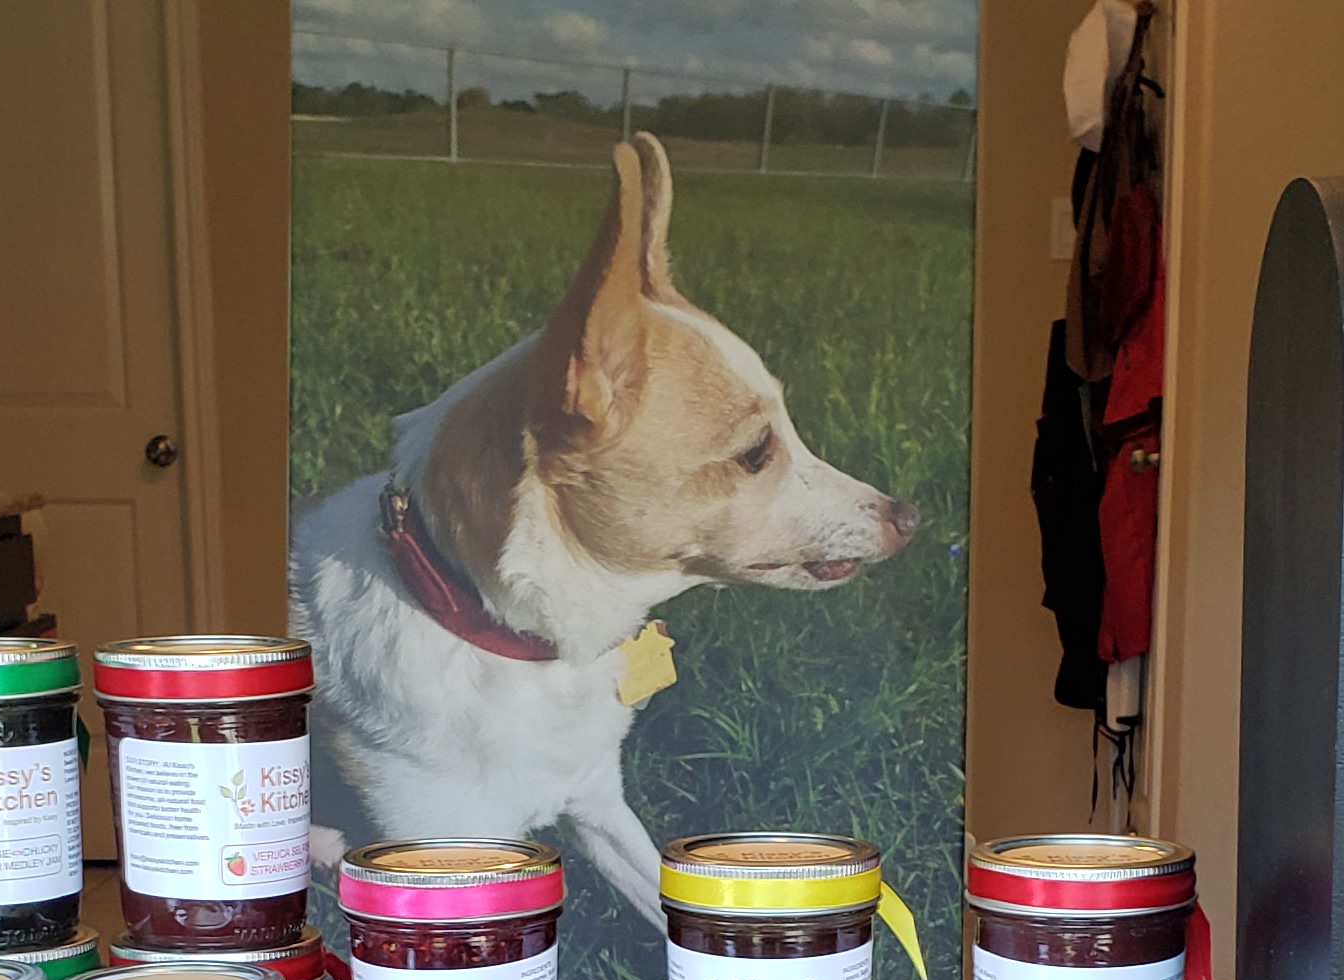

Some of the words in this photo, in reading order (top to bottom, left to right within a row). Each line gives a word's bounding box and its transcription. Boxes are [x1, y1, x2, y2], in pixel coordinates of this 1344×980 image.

[23, 844, 58, 856] CHUCKY
[6, 859, 44, 870] MEDLEY
[46, 856, 61, 866] JAM
